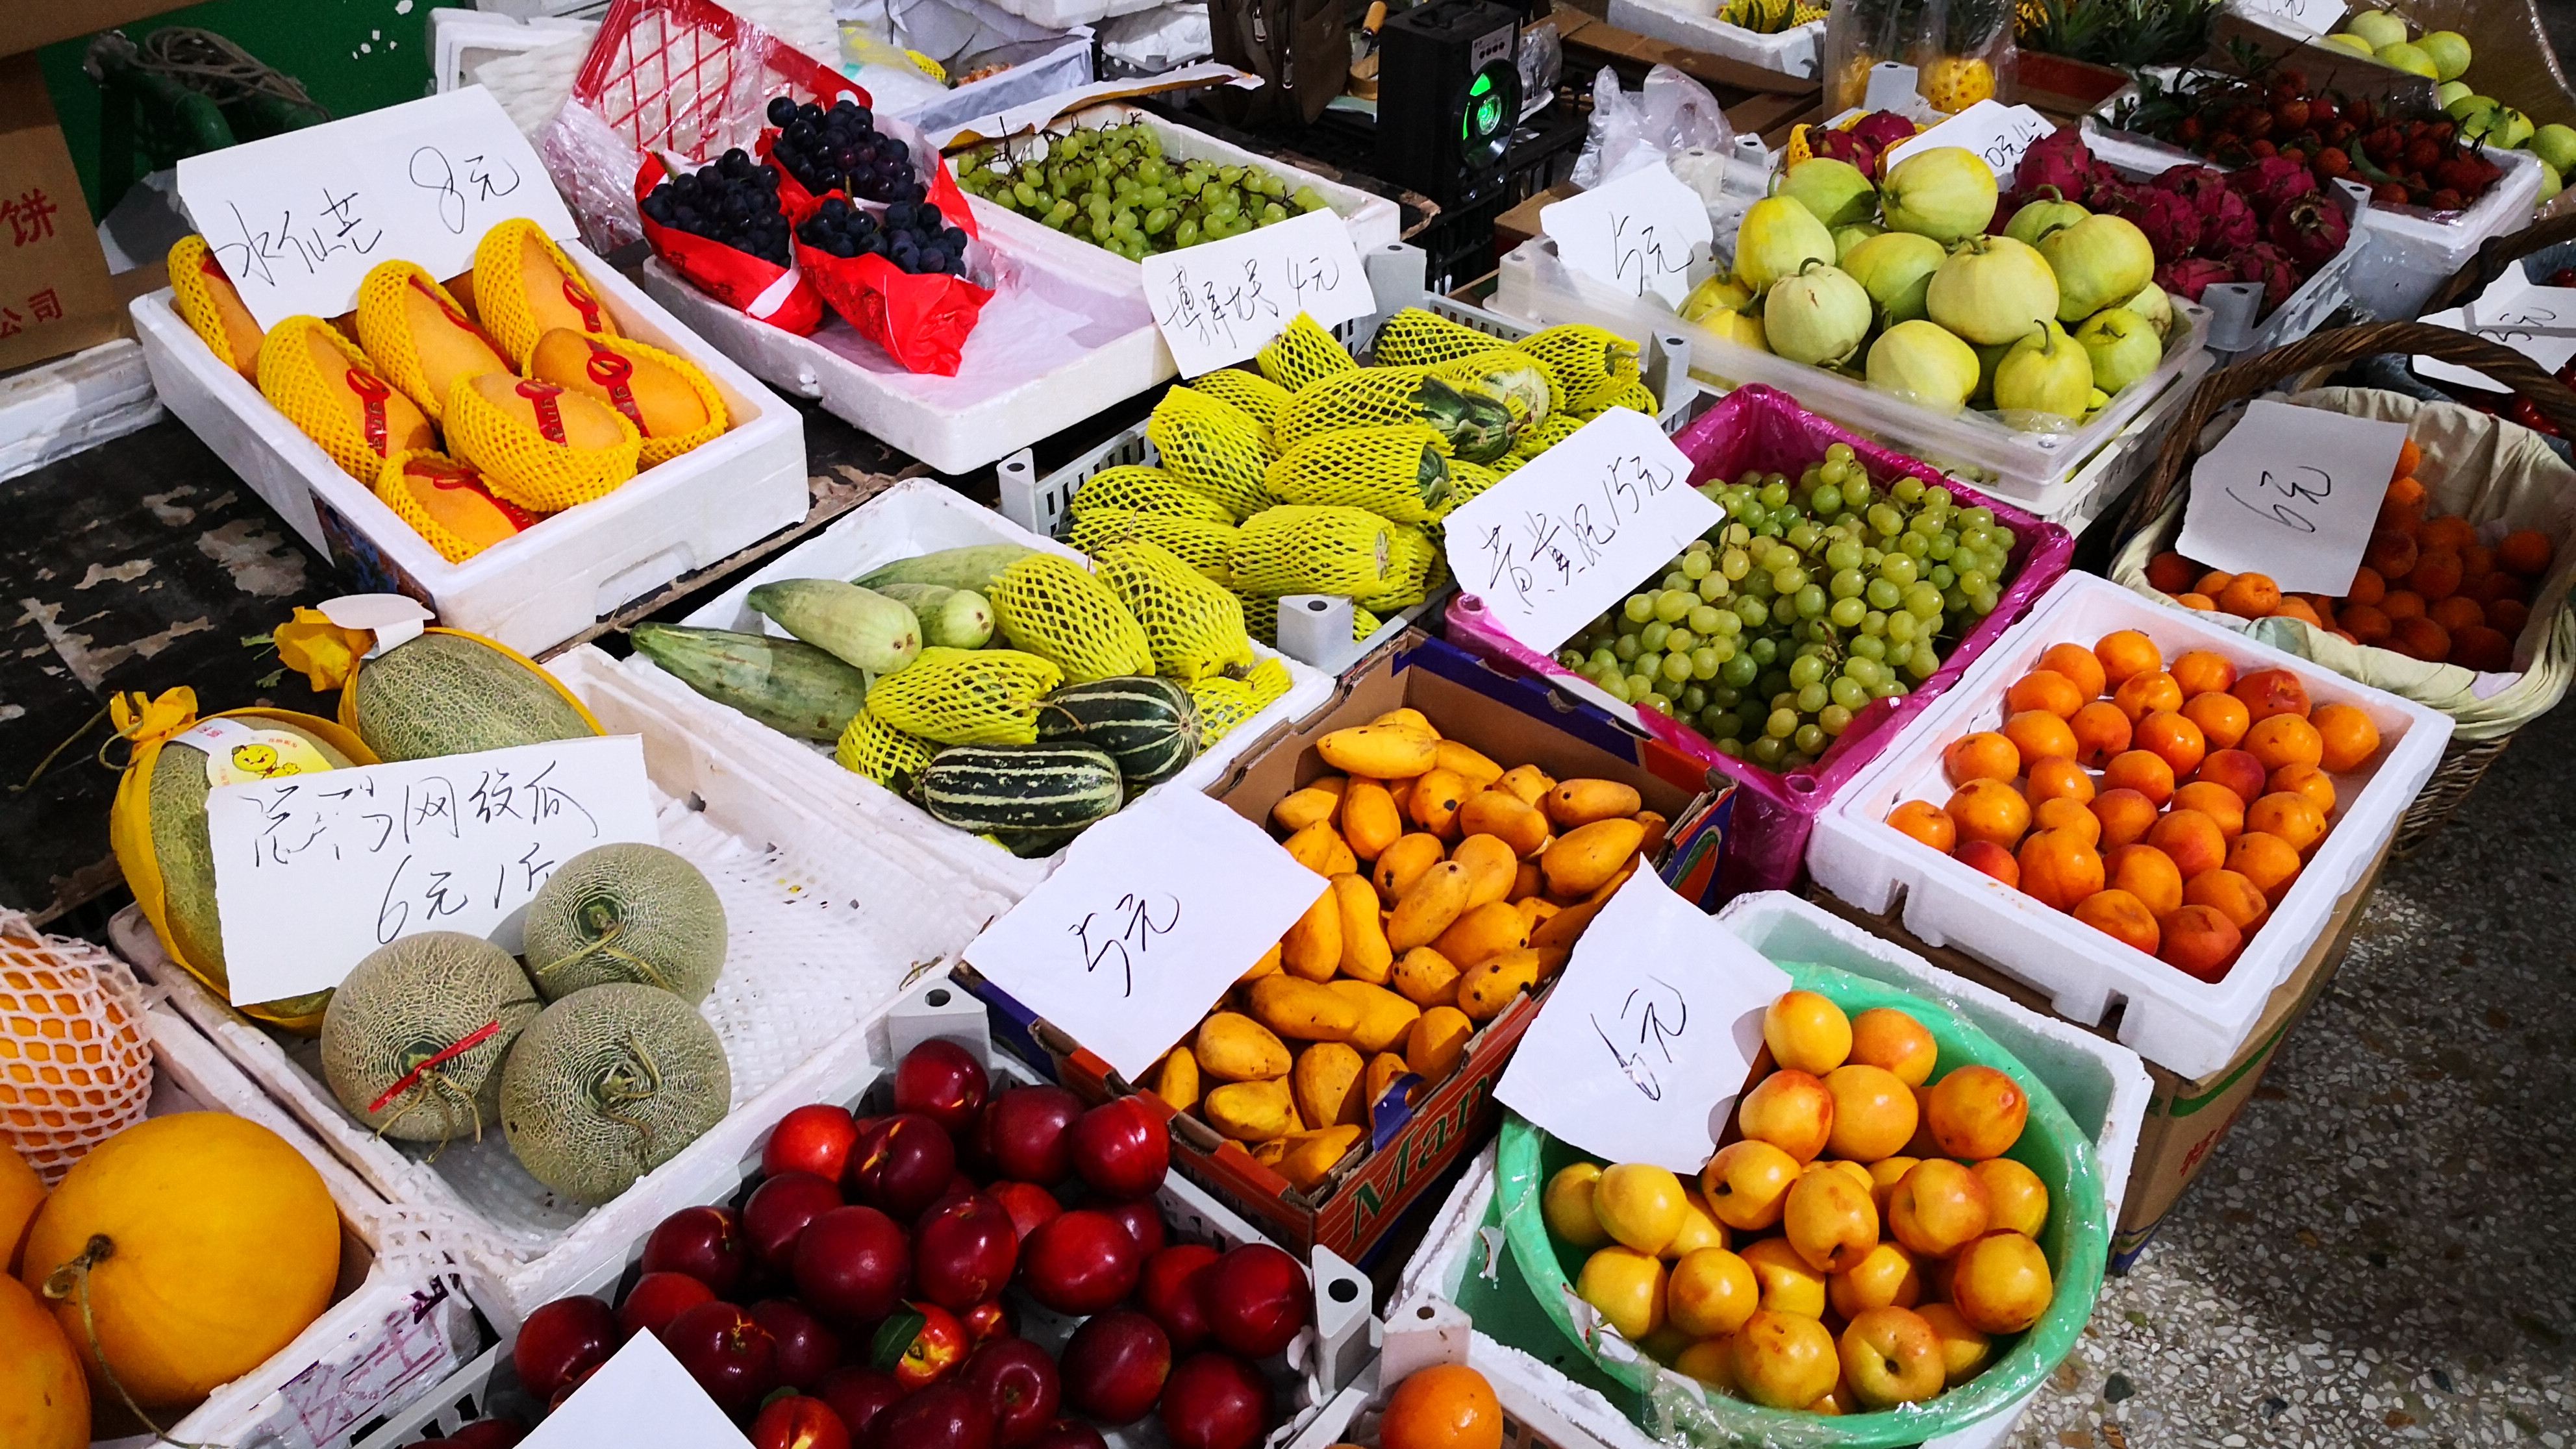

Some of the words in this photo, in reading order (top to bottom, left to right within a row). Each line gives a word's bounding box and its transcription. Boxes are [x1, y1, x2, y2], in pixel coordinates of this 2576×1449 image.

[410, 146, 520, 234] 8元
[1286, 256, 1340, 307] 4元
[1608, 211, 1695, 297] 5元
[2225, 465, 2331, 533] 6元
[1068, 891, 1180, 998] 5元
[1590, 973, 1686, 1102] 6元
